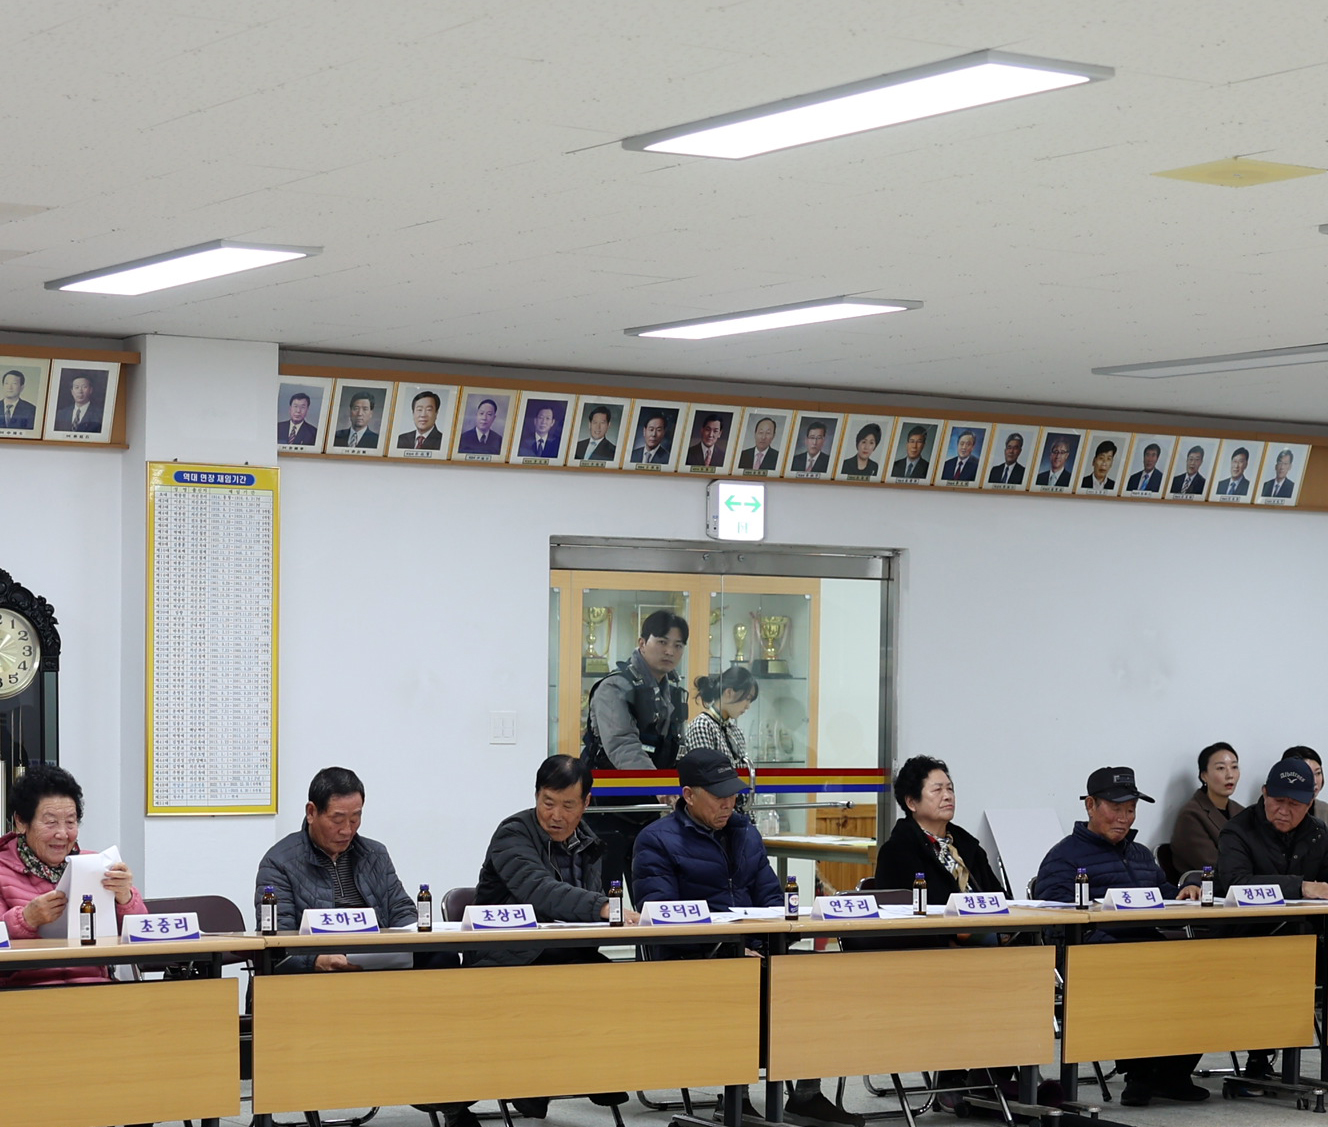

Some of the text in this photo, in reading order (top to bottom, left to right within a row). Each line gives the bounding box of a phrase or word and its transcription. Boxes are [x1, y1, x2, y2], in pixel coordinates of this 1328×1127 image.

[18, 630, 29, 641] 2
[22, 645, 32, 656] 3
[18, 661, 28, 671] 4
[8, 672, 18, 684] 5
[1244, 888, 1276, 900] 정지리
[830, 899, 869, 912] 연주리
[964, 895, 1000, 908] 청룡리
[483, 908, 526, 922] 초상리
[660, 904, 700, 918] 응덕리
[140, 917, 189, 933] 초중리
[321, 912, 366, 926] 초하리
